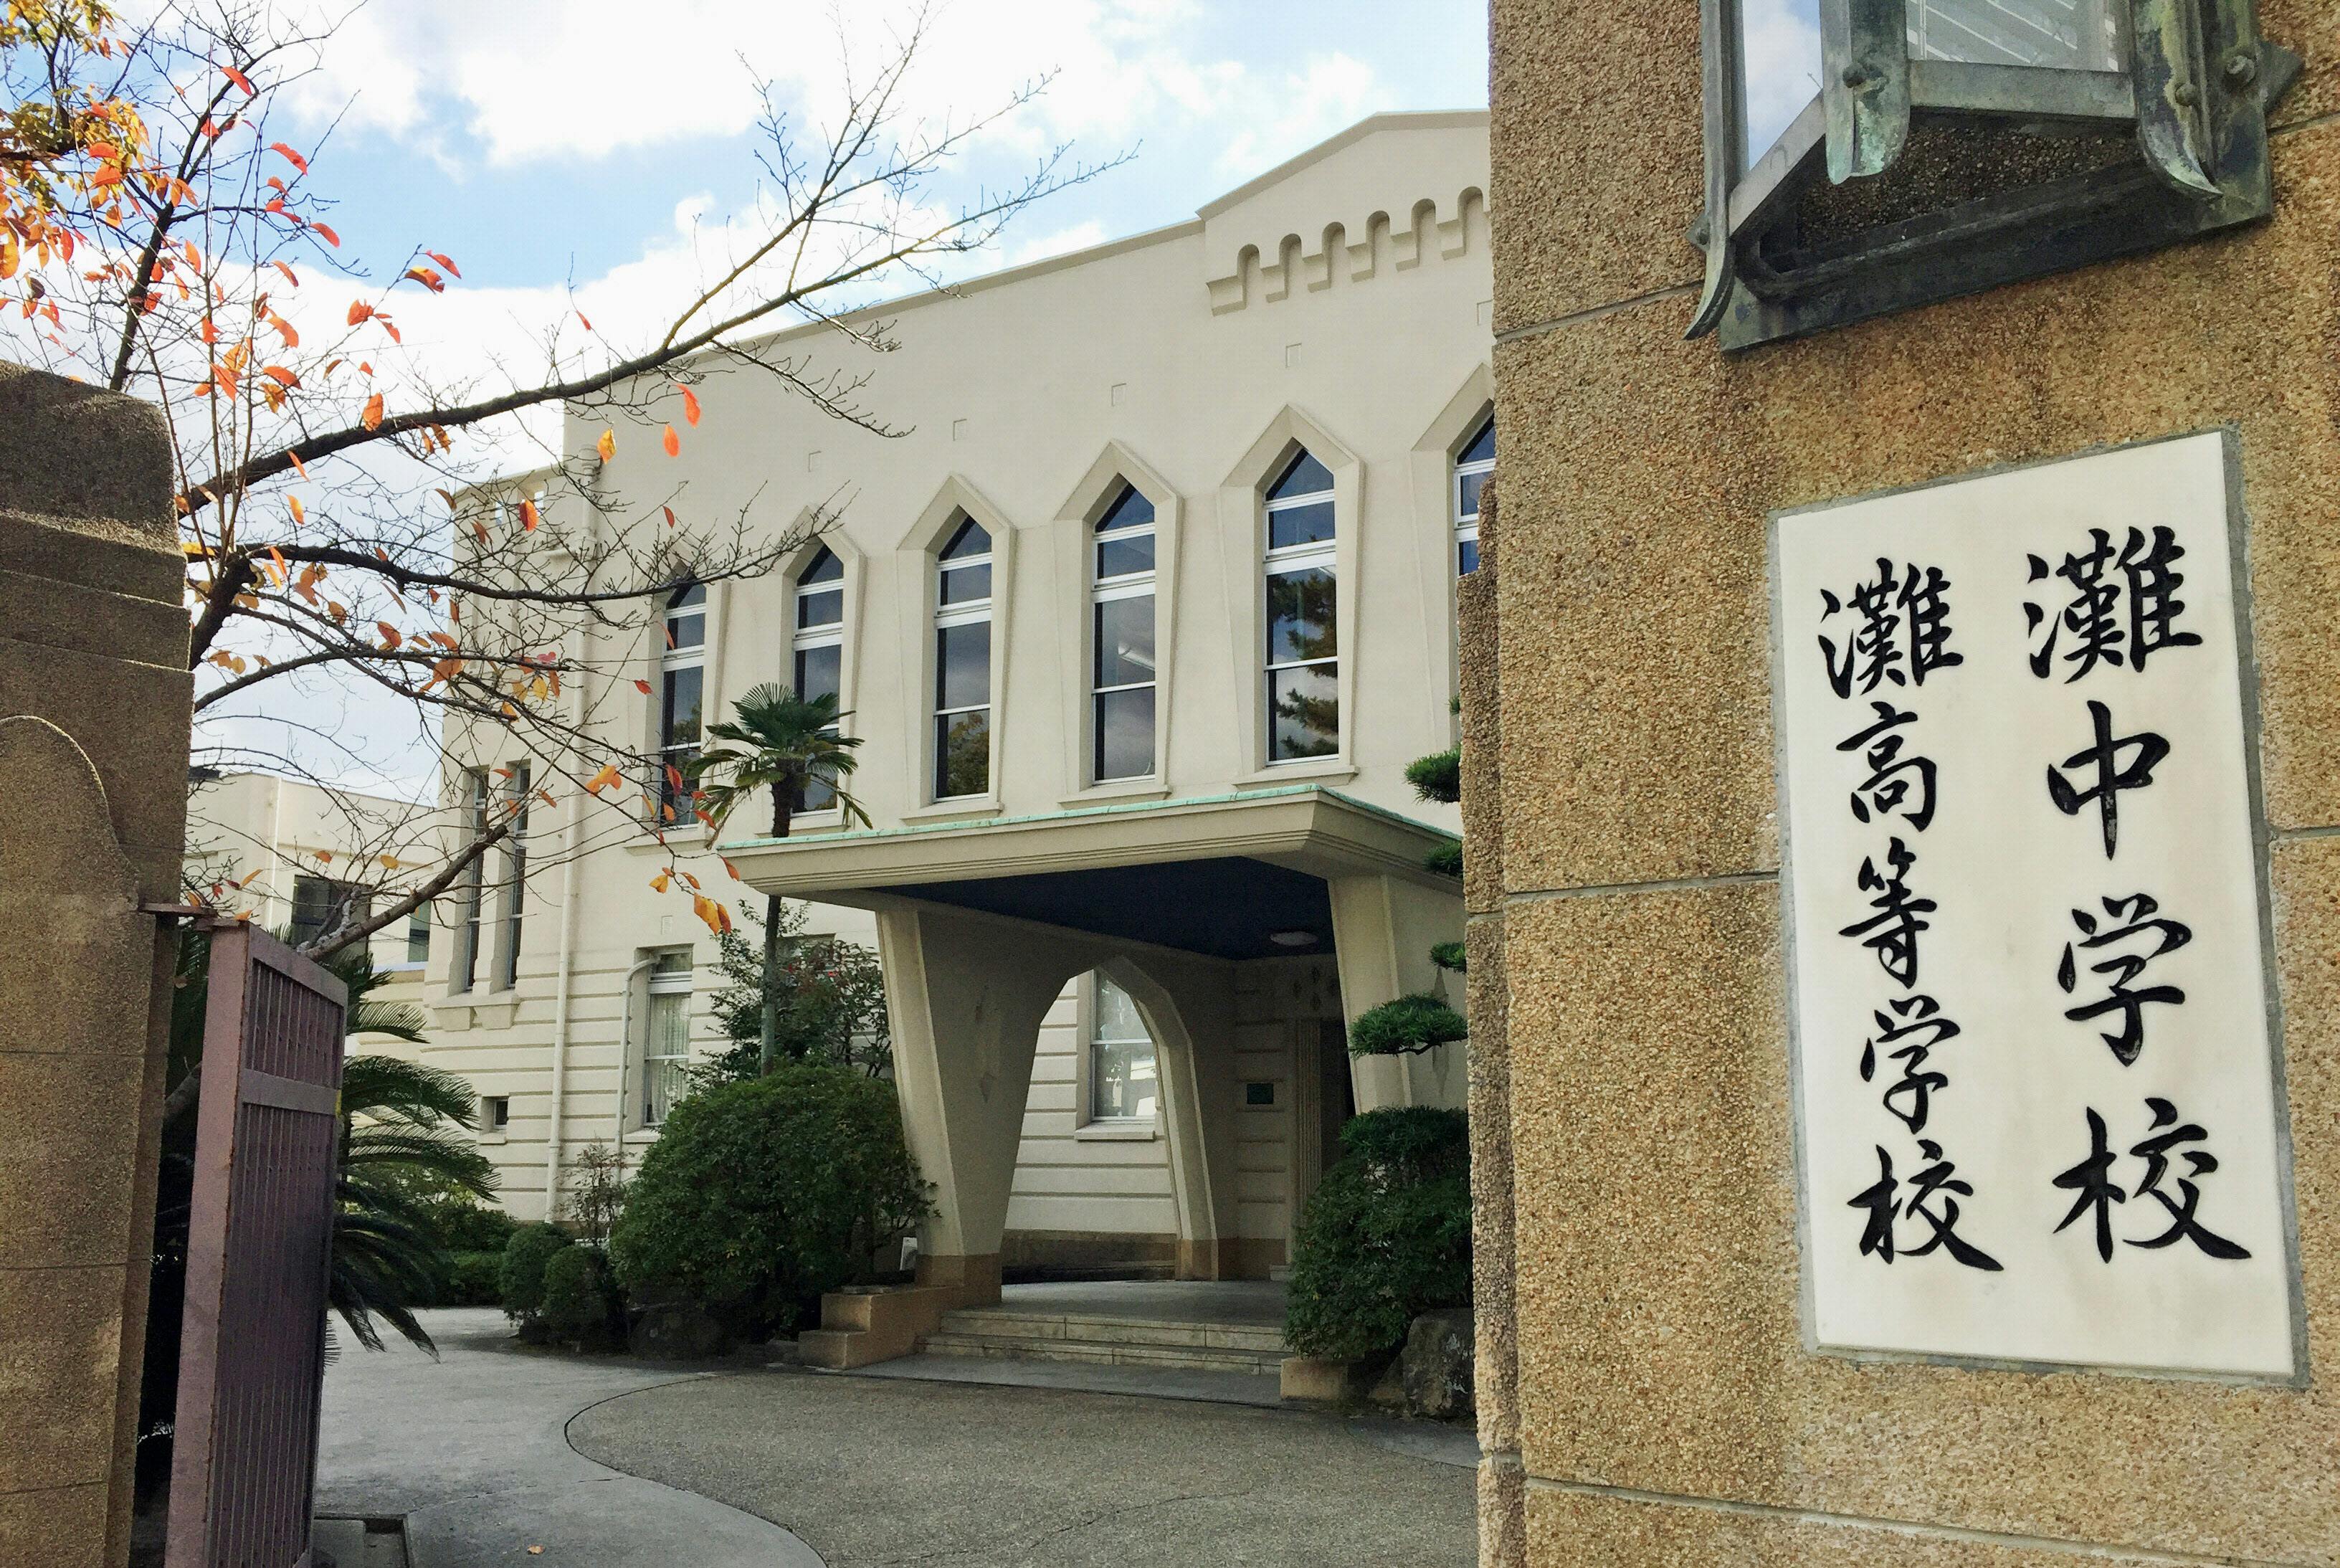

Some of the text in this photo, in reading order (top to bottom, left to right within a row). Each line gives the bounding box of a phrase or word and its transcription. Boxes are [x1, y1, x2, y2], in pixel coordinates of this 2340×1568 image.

[1817, 557, 2004, 1272] 灘高等学校
[2022, 525, 2252, 1265] 灘中学校
